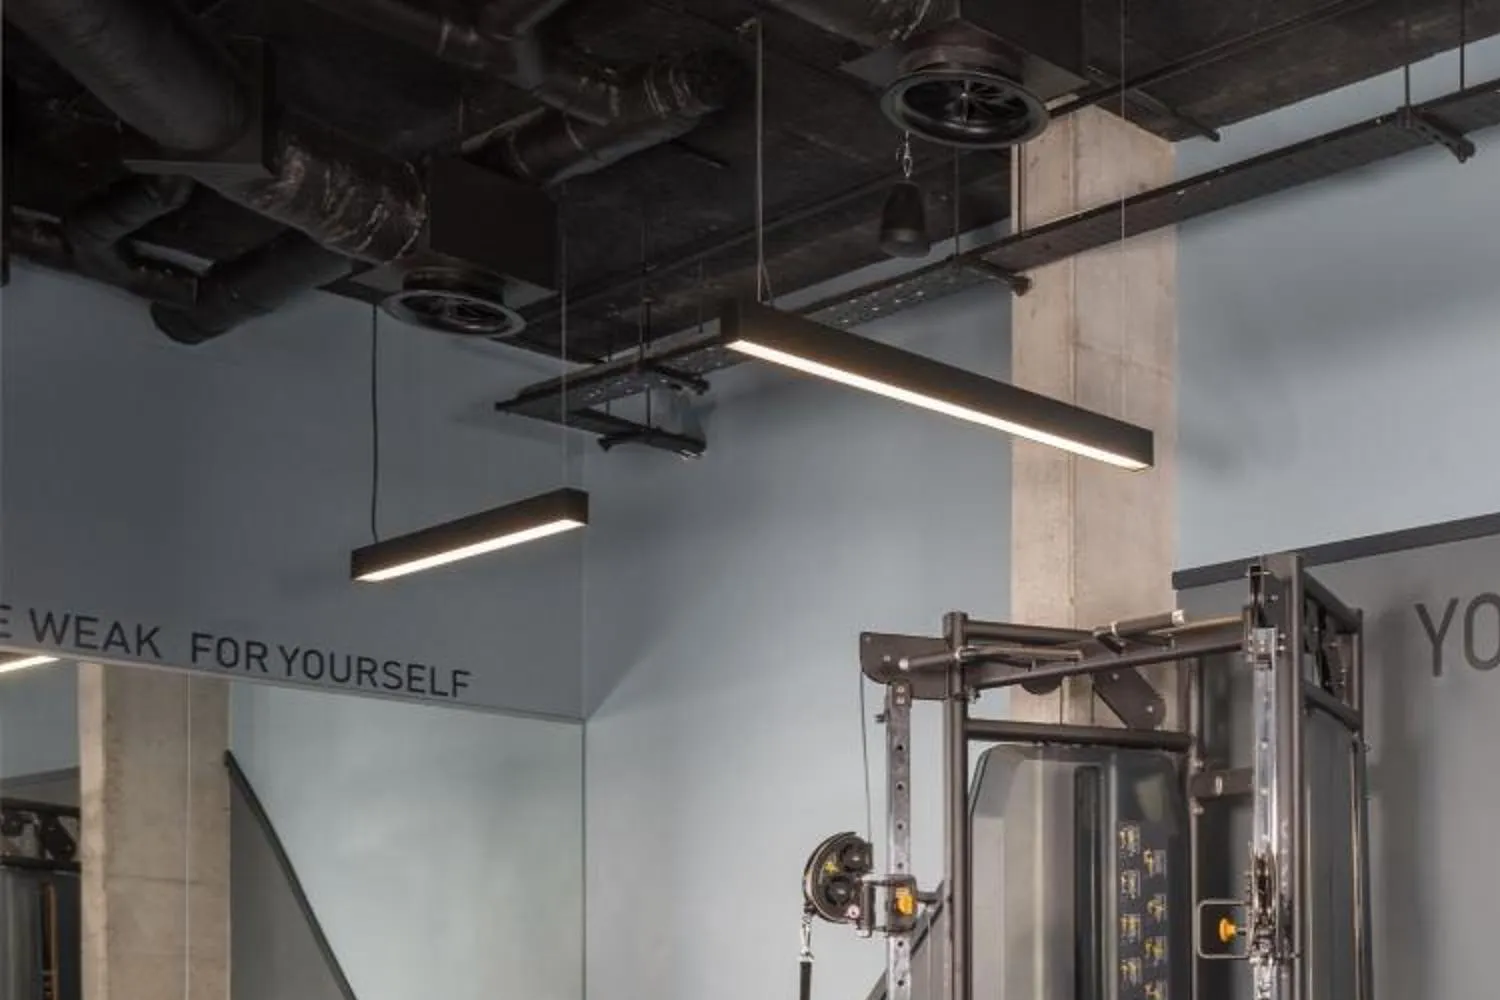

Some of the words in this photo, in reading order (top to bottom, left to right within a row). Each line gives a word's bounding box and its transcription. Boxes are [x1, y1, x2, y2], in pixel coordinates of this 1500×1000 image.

[28, 607, 163, 660] WEAK
[190, 631, 270, 674] FOR
[278, 644, 472, 699] YOURSELF
